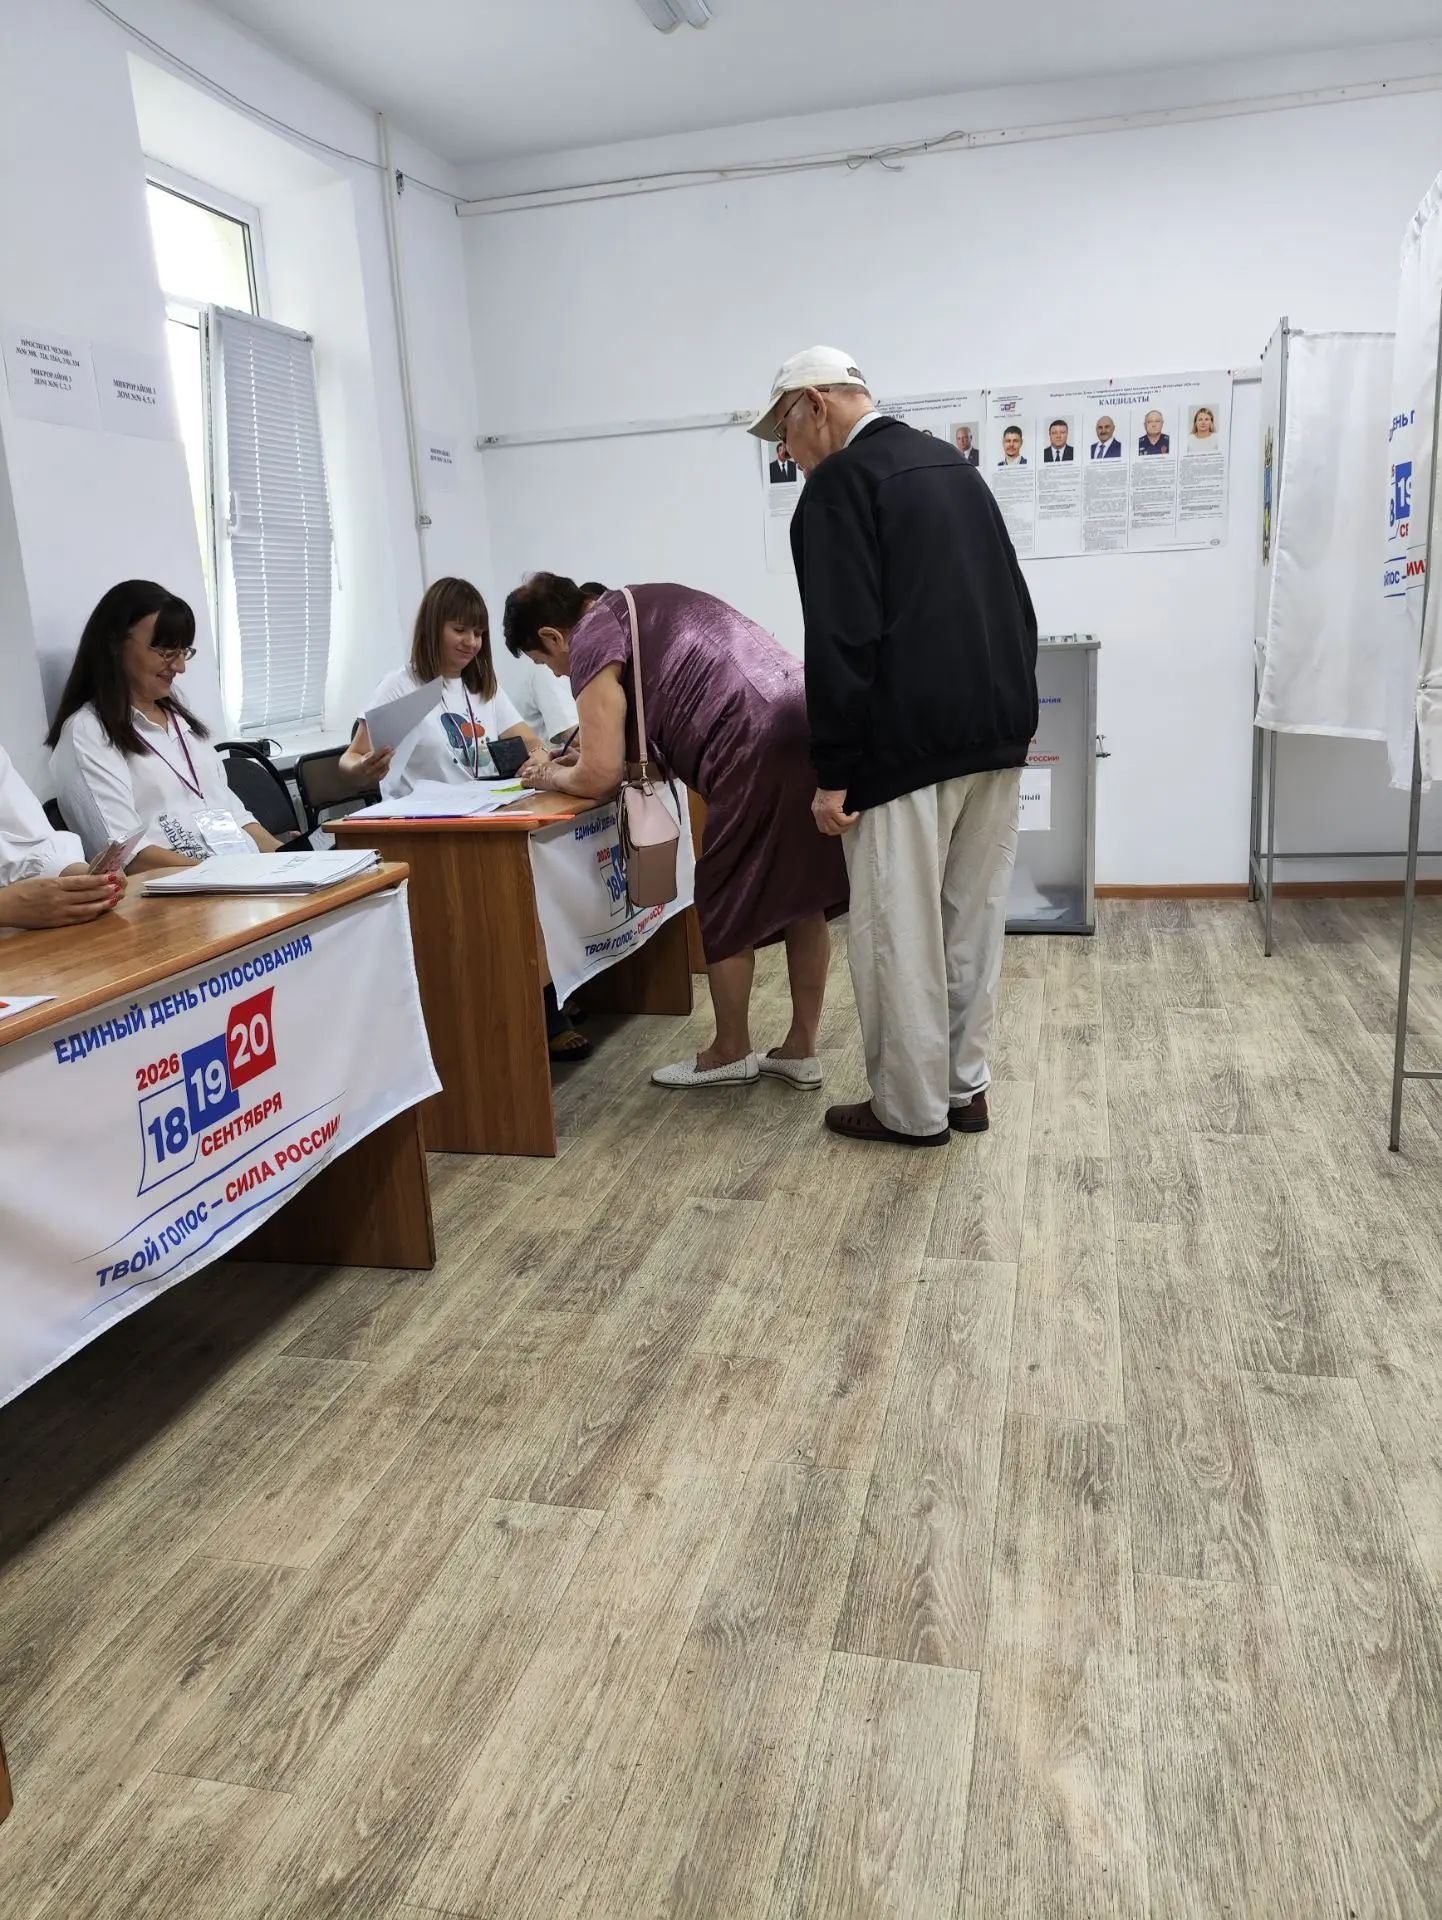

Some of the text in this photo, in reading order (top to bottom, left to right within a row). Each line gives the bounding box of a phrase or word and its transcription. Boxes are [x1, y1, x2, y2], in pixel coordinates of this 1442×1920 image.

[1099, 395, 1149, 406] КАНДИДАТЫ
[575, 817, 600, 841] ЕДИНЫЙ
[596, 847, 611, 863] 2026
[606, 876, 621, 903] 18
[584, 938, 612, 957] ТВОЙ
[611, 930, 633, 950] ГОЛОС
[54, 934, 313, 1065] ЕДИНЫЙ ДЕНЬ ГОЛОСОВАНИЯ
[135, 1053, 180, 1092] 2026
[148, 1012, 270, 1163] 18 19 20
[200, 1091, 283, 1157] СЕНТЯБРЯ
[95, 1237, 161, 1287] ТВОЙ
[159, 1201, 209, 1254] ГОЛОС
[225, 1162, 276, 1203] СИЛА
[274, 1113, 342, 1172] РОССИИ!
